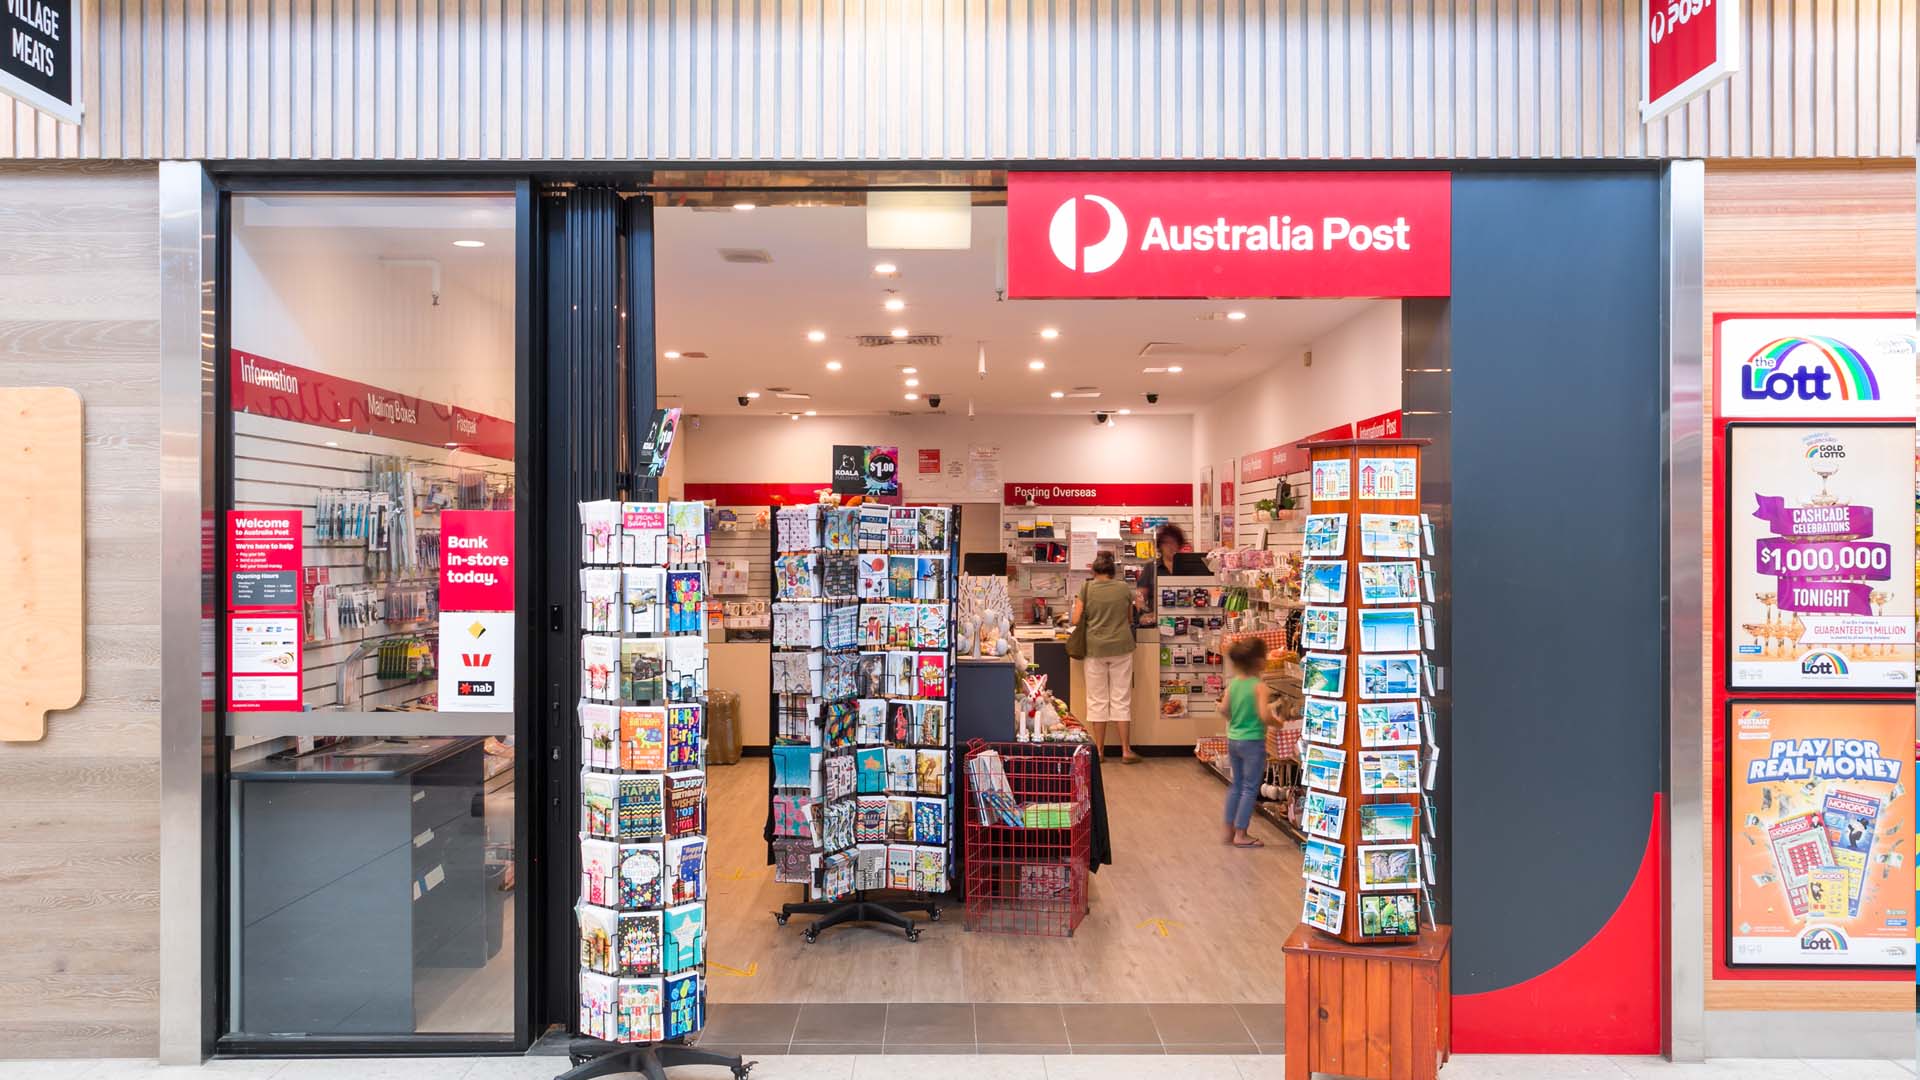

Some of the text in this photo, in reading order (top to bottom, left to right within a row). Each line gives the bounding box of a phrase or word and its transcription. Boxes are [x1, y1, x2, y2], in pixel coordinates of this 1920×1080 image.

[1668, 0, 1711, 34] POS
[12, 27, 54, 77] MEATS
[1141, 216, 1411, 251] Australia Post
[1755, 356, 1774, 367] the
[240, 356, 298, 395] Information
[1742, 364, 1832, 401] Lott
[367, 392, 417, 425] Mailing Boxes
[456, 413, 478, 437] Postpak
[1386, 417, 1397, 435] Post
[1819, 444, 1843, 452] GOLD
[870, 461, 894, 477] $1.00
[1014, 486, 1097, 499] Posting Overseas
[235, 518, 289, 528] Welcome
[1793, 506, 1850, 523] CASHCADE
[1793, 522, 1850, 534] CELEBRATIONS
[279, 543, 294, 551] help
[447, 535, 488, 549] Bank
[447, 552, 509, 566] in-store
[1761, 546, 1887, 574] $1,000,000
[447, 569, 498, 586] today.
[1793, 588, 1850, 607] TONIGHT
[1814, 626, 1864, 635] GUARANTEED
[1874, 625, 1907, 635] MILLION
[1801, 662, 1832, 674] Lott
[472, 683, 492, 693] nab
[669, 708, 699, 729] Happy
[1772, 740, 1879, 759] PLAY FOR
[1750, 758, 1901, 780] REAL MONEY
[620, 786, 659, 796] HAPPY
[1828, 799, 1875, 817] MONOPOLY
[1801, 937, 1832, 950] Lott
